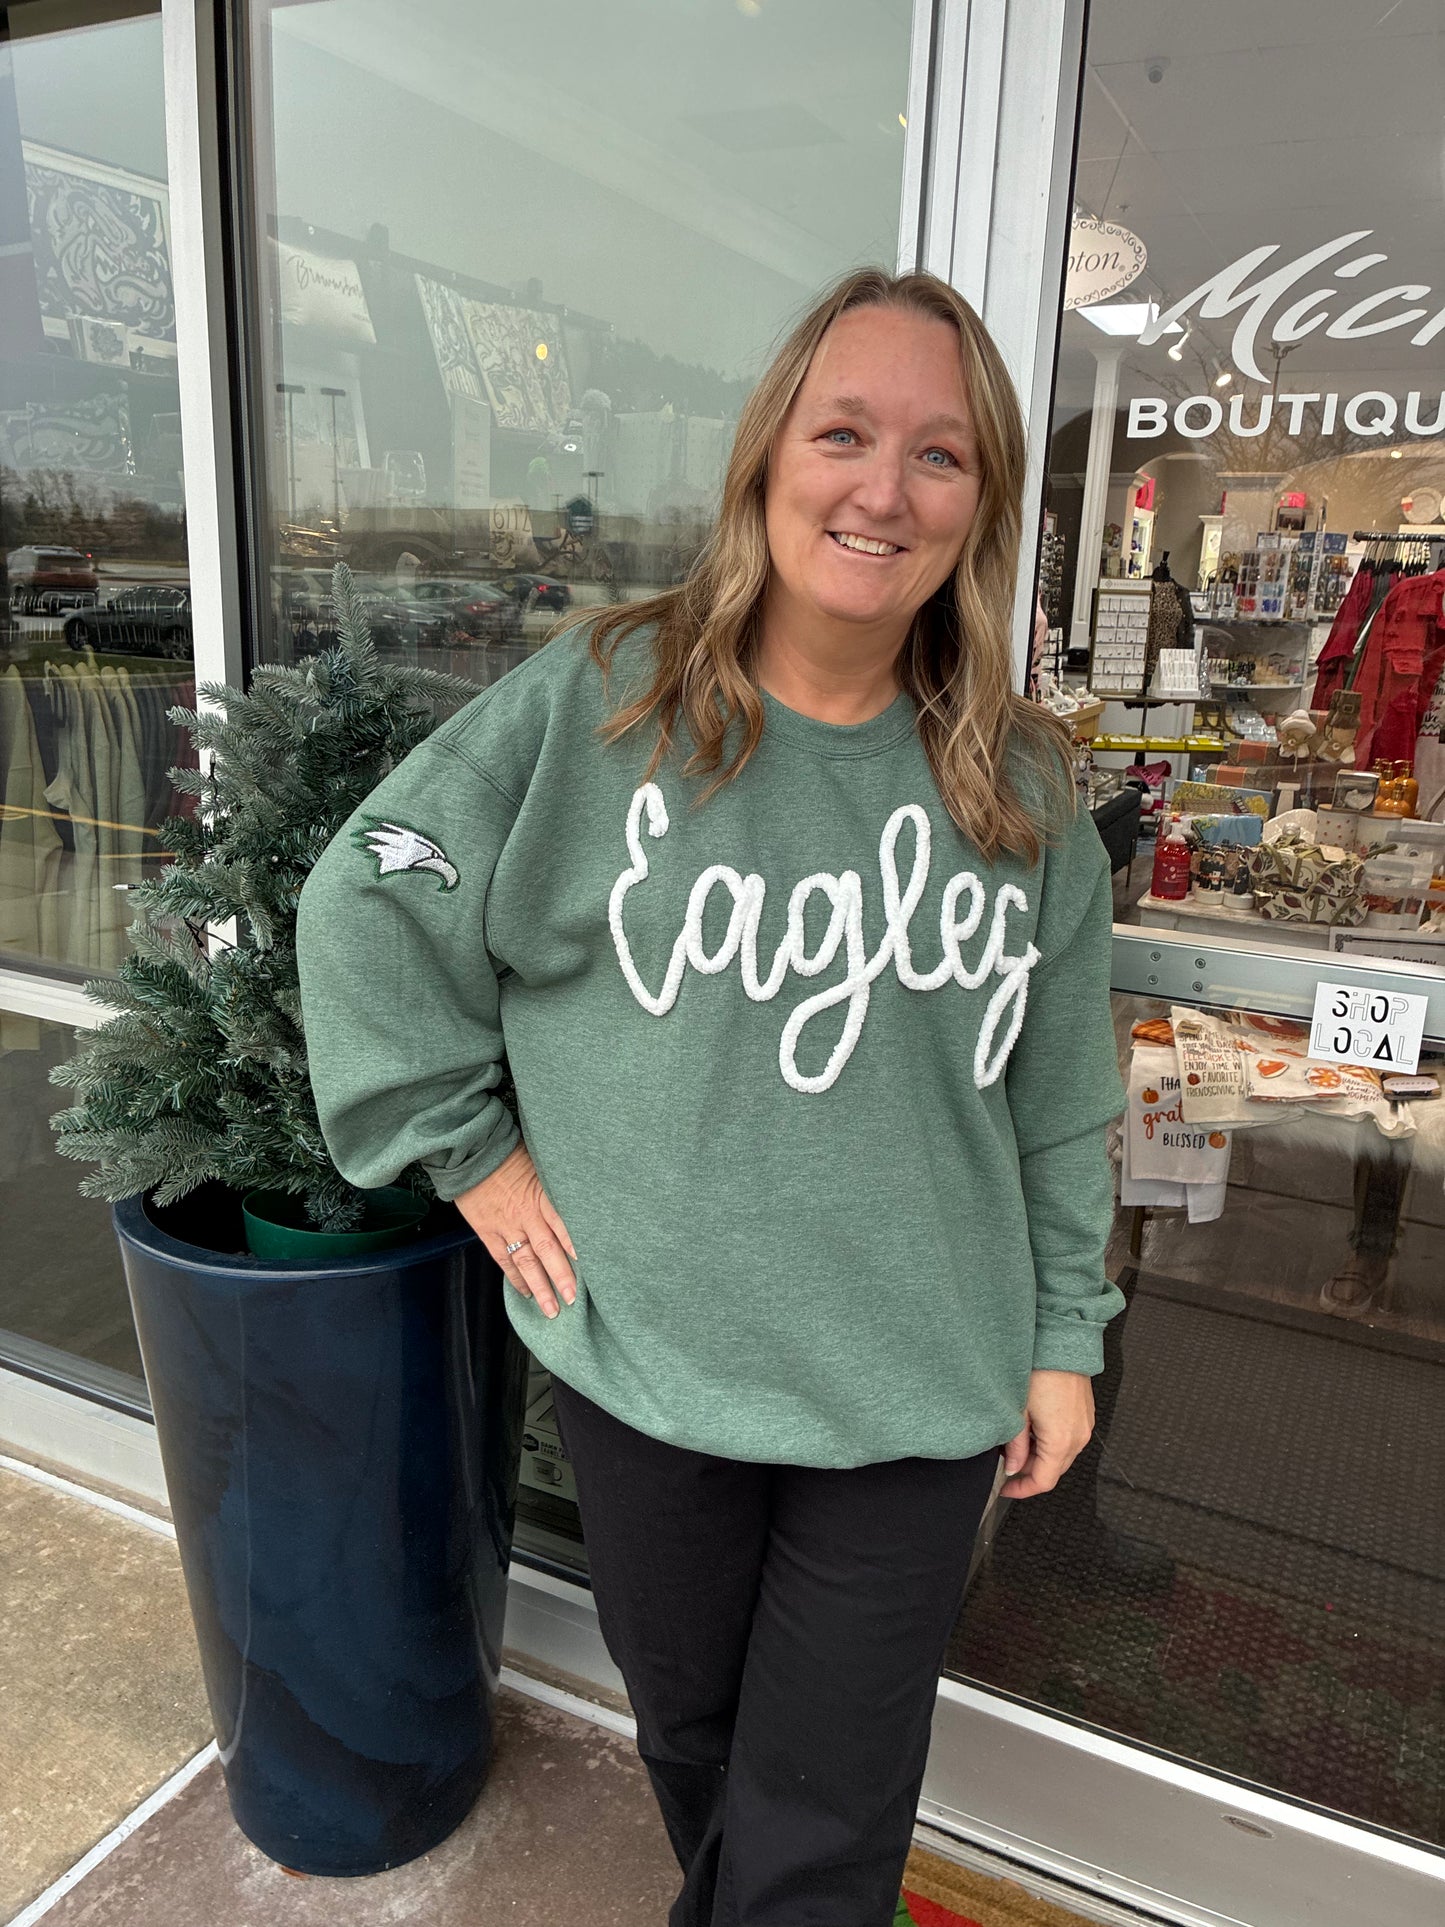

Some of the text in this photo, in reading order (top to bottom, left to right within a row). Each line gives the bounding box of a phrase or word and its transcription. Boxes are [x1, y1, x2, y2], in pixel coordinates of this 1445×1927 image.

[1332, 990, 1410, 1026] SHOP
[1313, 1022, 1414, 1066] LOCAL
[1184, 1061, 1208, 1071] ENJOY
[1160, 1076, 1181, 1091] THA
[1202, 1071, 1239, 1083] FAVORITE
[1143, 1096, 1185, 1140] grat
[1163, 1132, 1206, 1149] BLESSED
